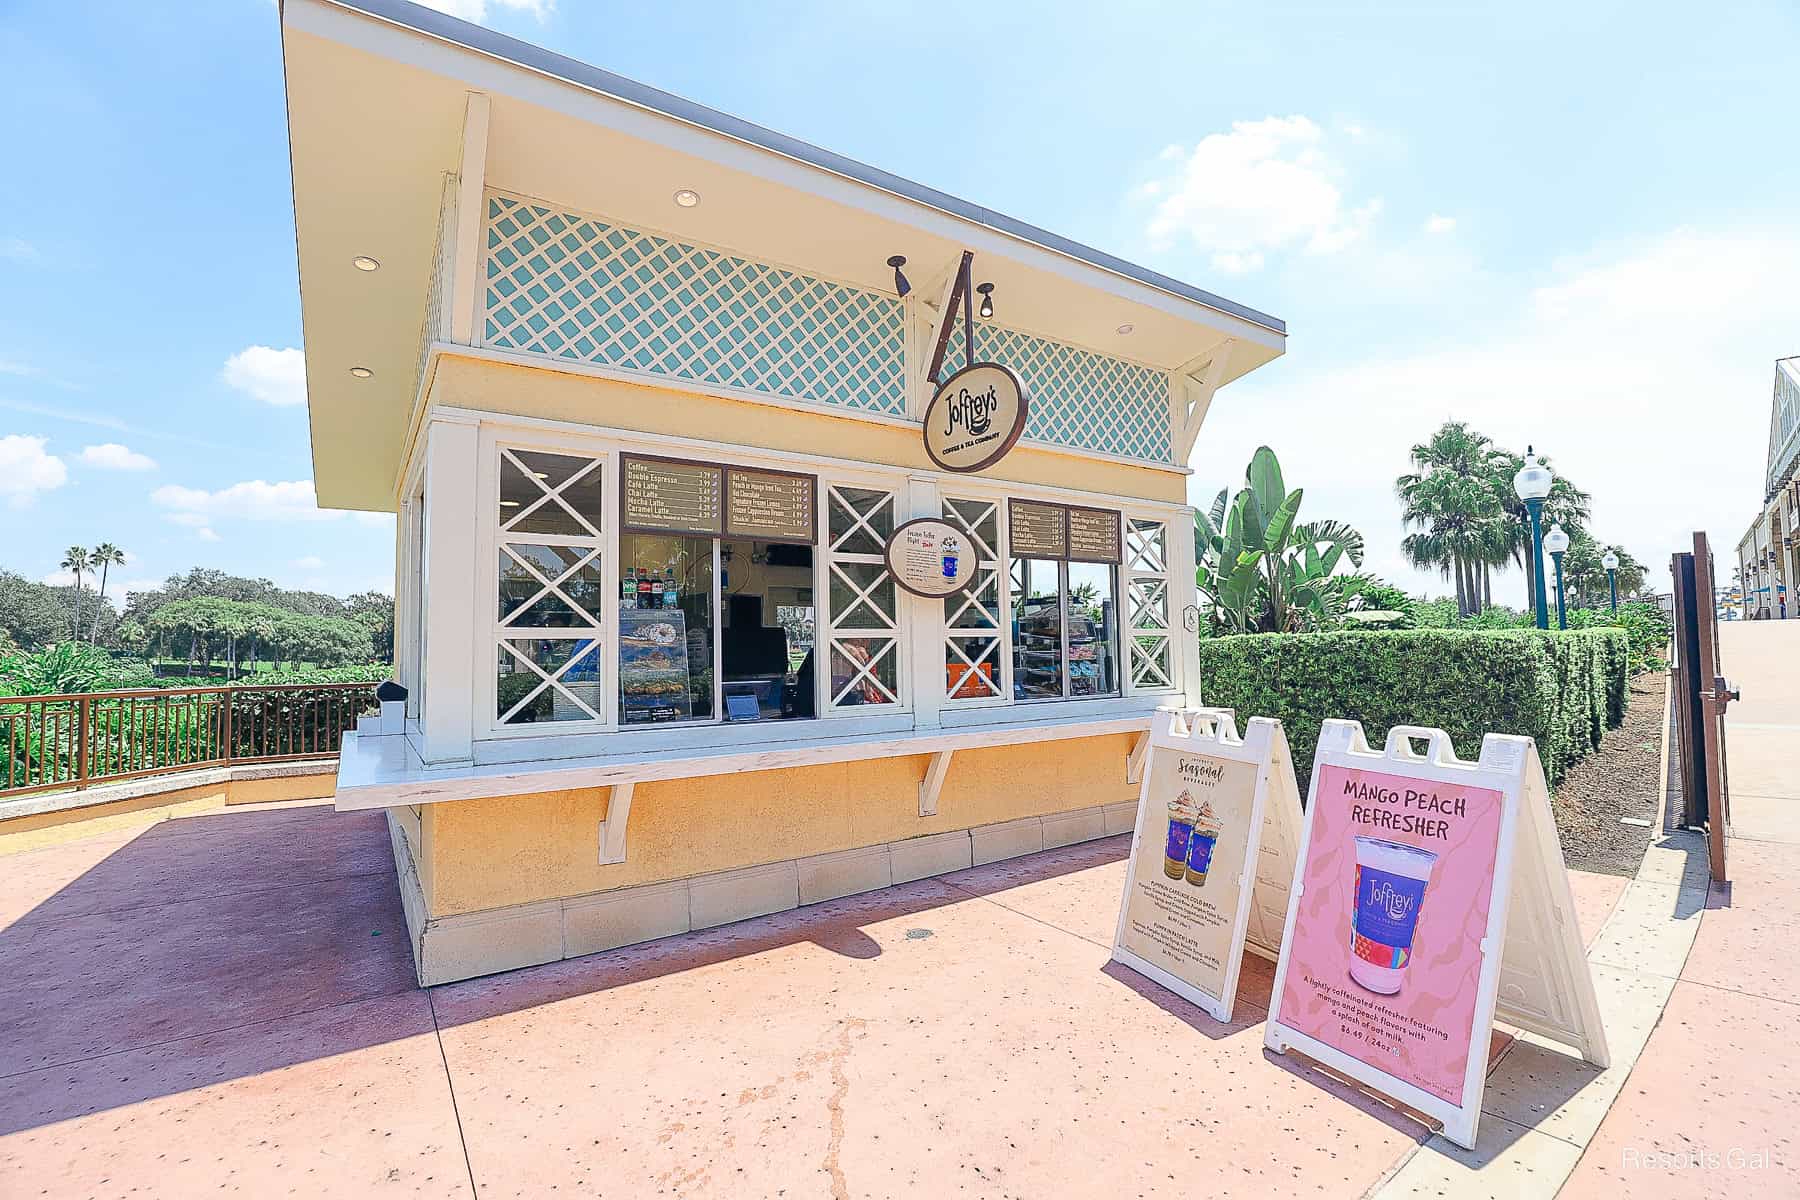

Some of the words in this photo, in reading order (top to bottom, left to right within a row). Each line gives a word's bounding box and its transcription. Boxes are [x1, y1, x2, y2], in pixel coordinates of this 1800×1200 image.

[944, 385, 997, 436] Joffrey's
[942, 445, 960, 455] COFFEE
[965, 440, 974, 448] TEA
[974, 432, 1000, 444] COMPANY
[628, 463, 648, 471] Coffee
[628, 472, 649, 481] Double
[650, 474, 678, 485] Espresso
[642, 490, 658, 498] Latte
[643, 481, 658, 490] Latte
[628, 504, 653, 513] Caramel
[655, 505, 670, 514] Latte
[650, 498, 665, 507] Latte
[1178, 758, 1225, 783] Seasonal
[1344, 780, 1399, 804] MANGO
[1404, 790, 1466, 818] PEACH
[1352, 804, 1449, 840] REFRESHER
[1366, 879, 1414, 913] Joffrey's
[1309, 977, 1330, 994] lightly
[1332, 988, 1373, 1010] caffeinated
[1374, 1003, 1408, 1024] refresher
[1409, 1017, 1448, 1041] featuring
[1317, 992, 1340, 1008] mango
[1341, 1002, 1356, 1013] and
[1356, 1008, 1379, 1022] peach
[1380, 1016, 1407, 1034] flavors
[1408, 1029, 1426, 1042] with
[1338, 1011, 1360, 1026] splash
[1361, 1020, 1370, 1029] of
[1370, 1026, 1384, 1036] oat
[1340, 1024, 1362, 1040] $6.49
[1370, 1038, 1391, 1052] 24oz
